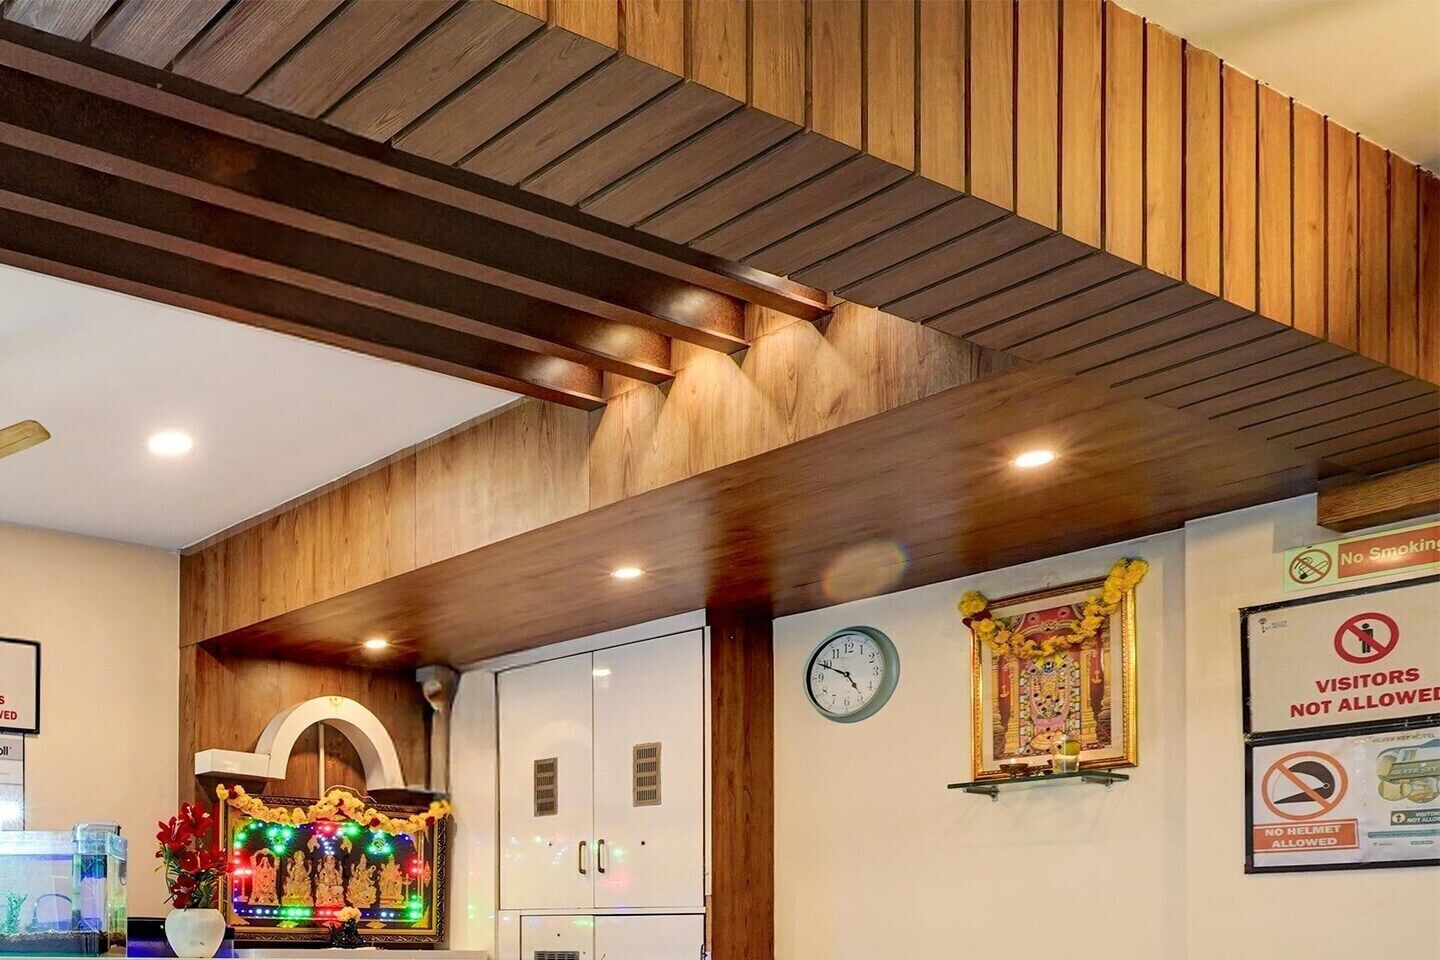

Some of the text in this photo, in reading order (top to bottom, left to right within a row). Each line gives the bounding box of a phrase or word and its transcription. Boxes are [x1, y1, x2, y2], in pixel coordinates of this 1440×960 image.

[1340, 551, 1364, 566] No
[1315, 667, 1420, 693] VISITORS
[1290, 700, 1332, 718] NOT
[1265, 825, 1341, 837] NO HELMET
[1272, 837, 1337, 848] ALLOWED
